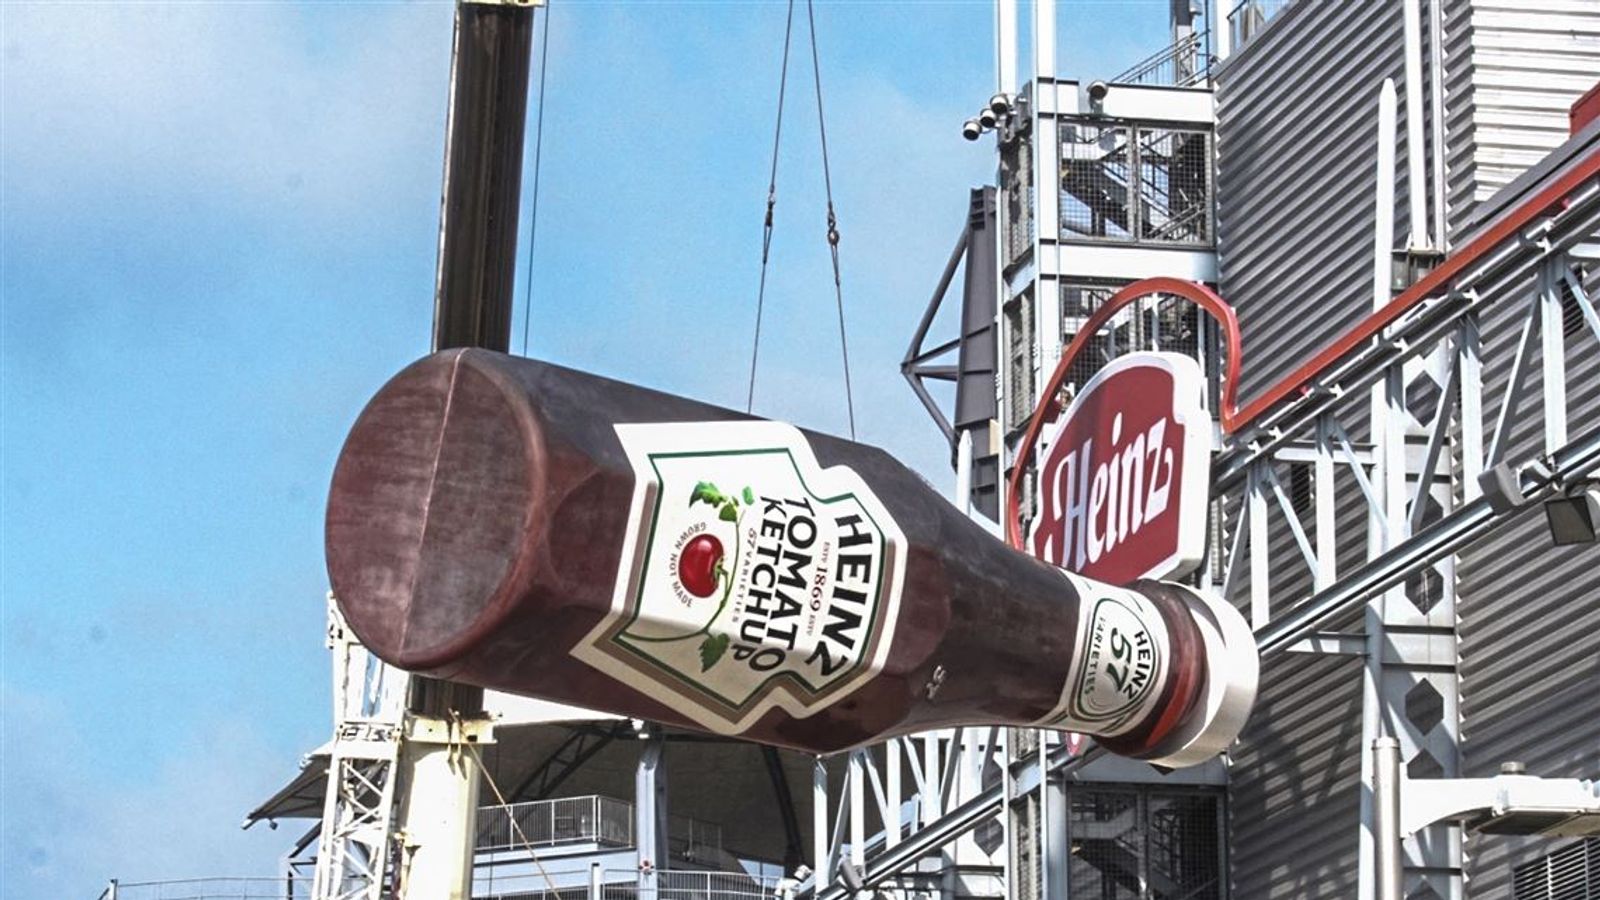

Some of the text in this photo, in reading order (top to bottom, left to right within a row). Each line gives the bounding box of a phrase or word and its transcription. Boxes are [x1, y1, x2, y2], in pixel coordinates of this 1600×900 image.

[1043, 411, 1174, 572] Heinz
[669, 521, 707, 608] GROWN NOT MADE
[731, 496, 787, 661] KETCHUP
[731, 551, 752, 622] VARIETIES
[748, 497, 817, 671] TOMATO
[804, 514, 873, 676] HEINZ
[809, 566, 828, 612] 1869
[1084, 616, 1106, 694] VARIETIES
[1106, 627, 1132, 691] 57
[1122, 630, 1151, 699] HEINZ
